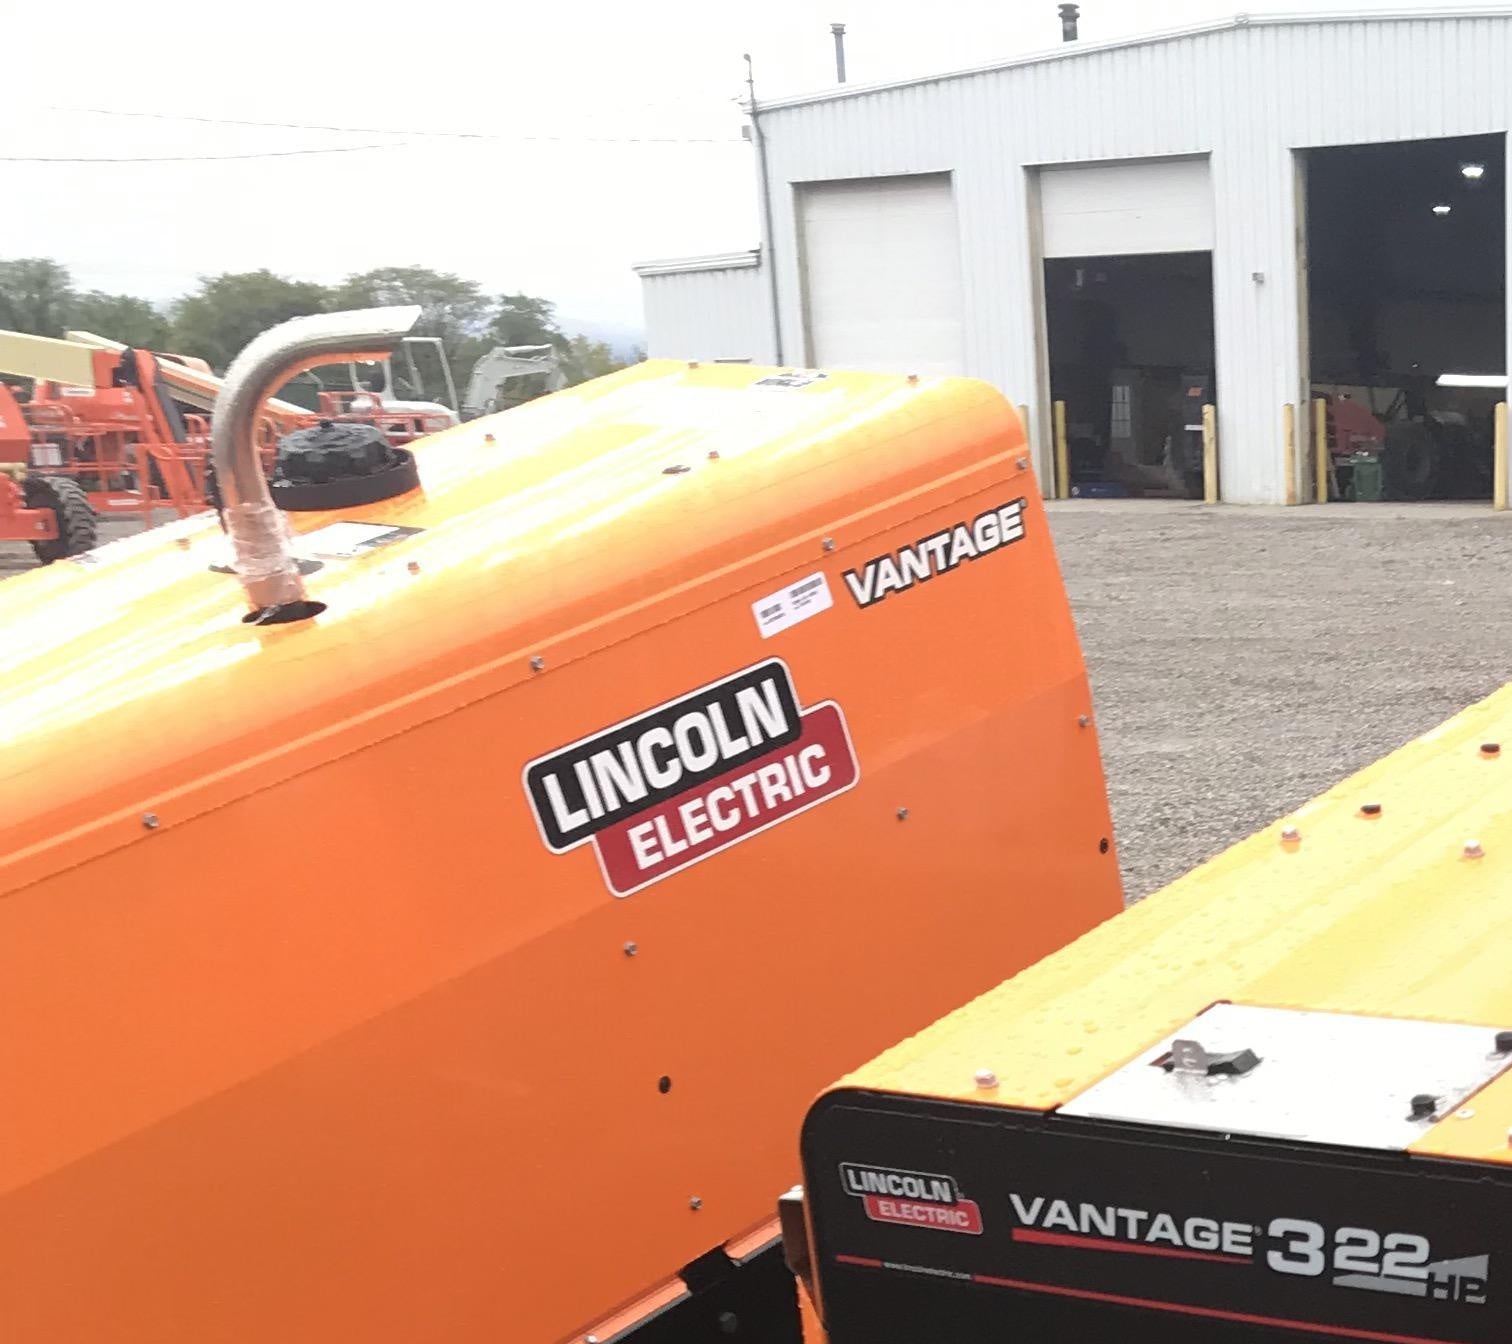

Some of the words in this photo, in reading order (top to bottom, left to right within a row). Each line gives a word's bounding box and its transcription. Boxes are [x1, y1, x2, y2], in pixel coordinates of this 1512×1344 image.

[844, 502, 1025, 607] VANTAGE
[542, 678, 789, 833] LINCOLN
[626, 743, 831, 871] ELECTRIC
[847, 1169, 952, 1202] LINCOLN
[877, 1200, 970, 1227] ELECTRIC
[1009, 1193, 1254, 1255] VANTAGE
